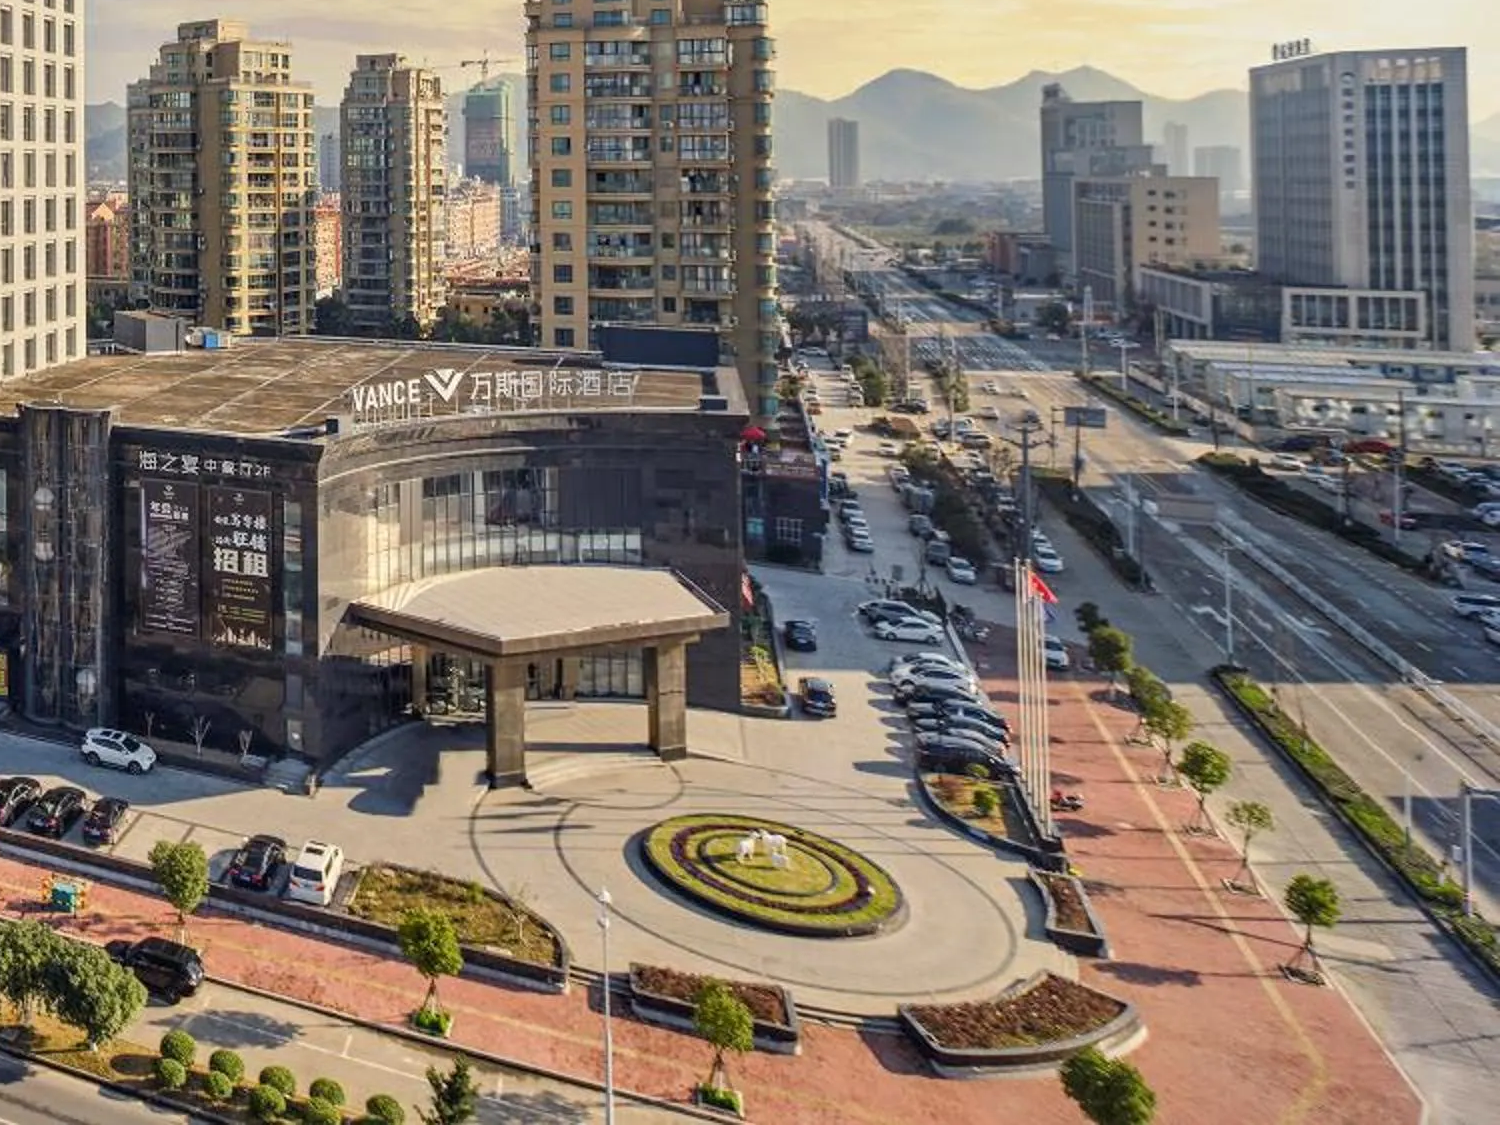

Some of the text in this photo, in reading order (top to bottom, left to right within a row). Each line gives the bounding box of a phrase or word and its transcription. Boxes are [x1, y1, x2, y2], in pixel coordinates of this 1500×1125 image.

[352, 378, 421, 412] VANCE
[469, 370, 634, 401] 万斯国际酒店
[213, 547, 269, 578] 招租
